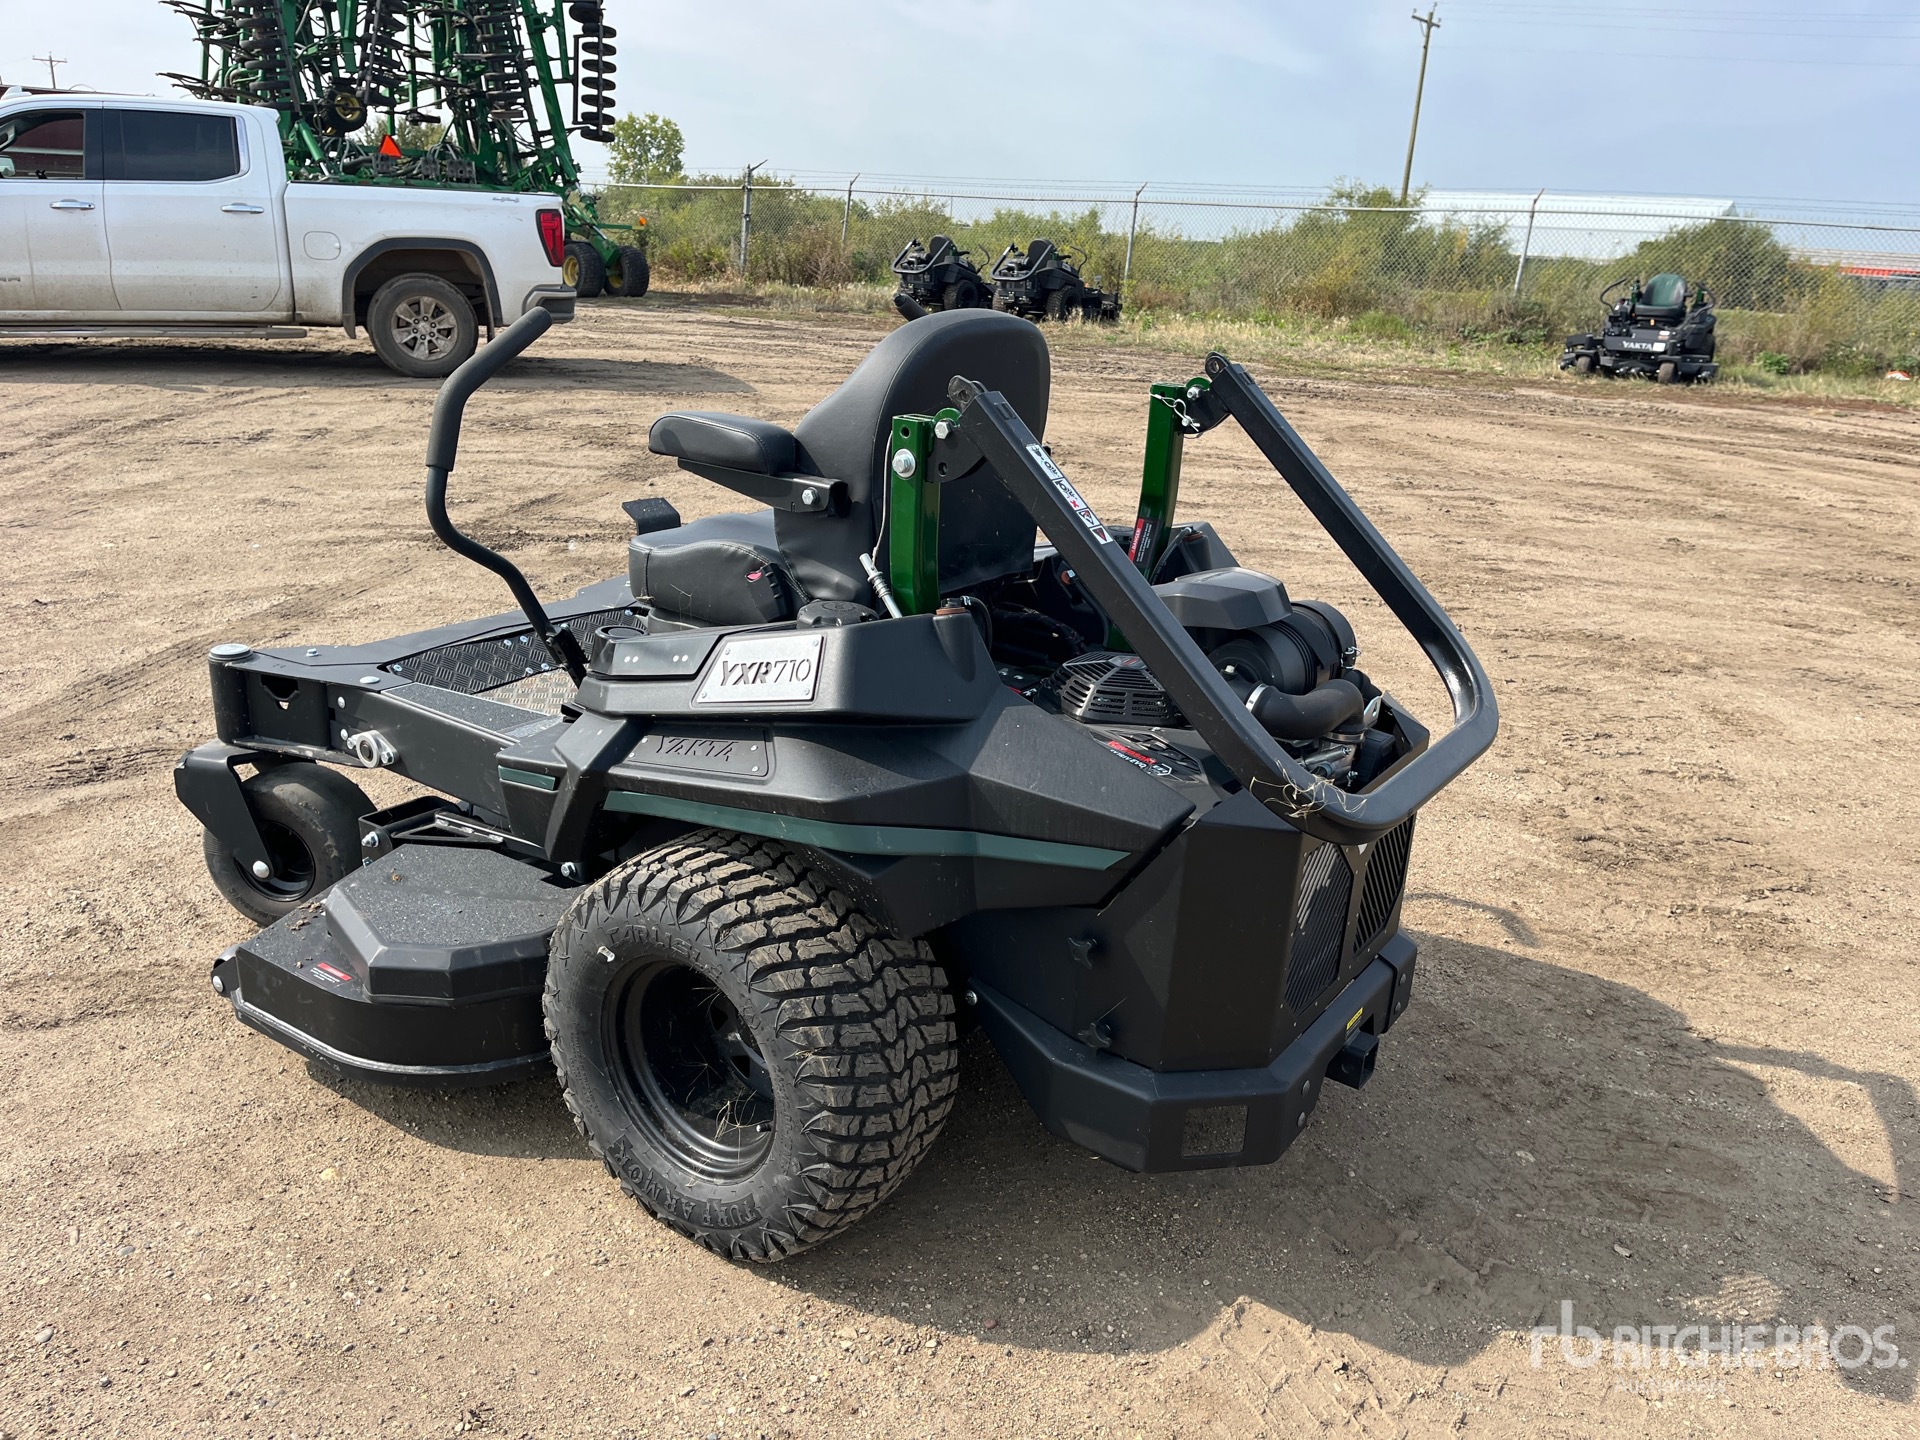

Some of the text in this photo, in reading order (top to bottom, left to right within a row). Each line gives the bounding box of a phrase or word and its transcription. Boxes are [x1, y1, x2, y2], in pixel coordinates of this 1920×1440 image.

[1622, 340, 1653, 350] YAKTA
[720, 658, 812, 686] YXR710
[655, 733, 739, 762] YAKTA
[611, 1138, 757, 1227] TURF ARMOR
